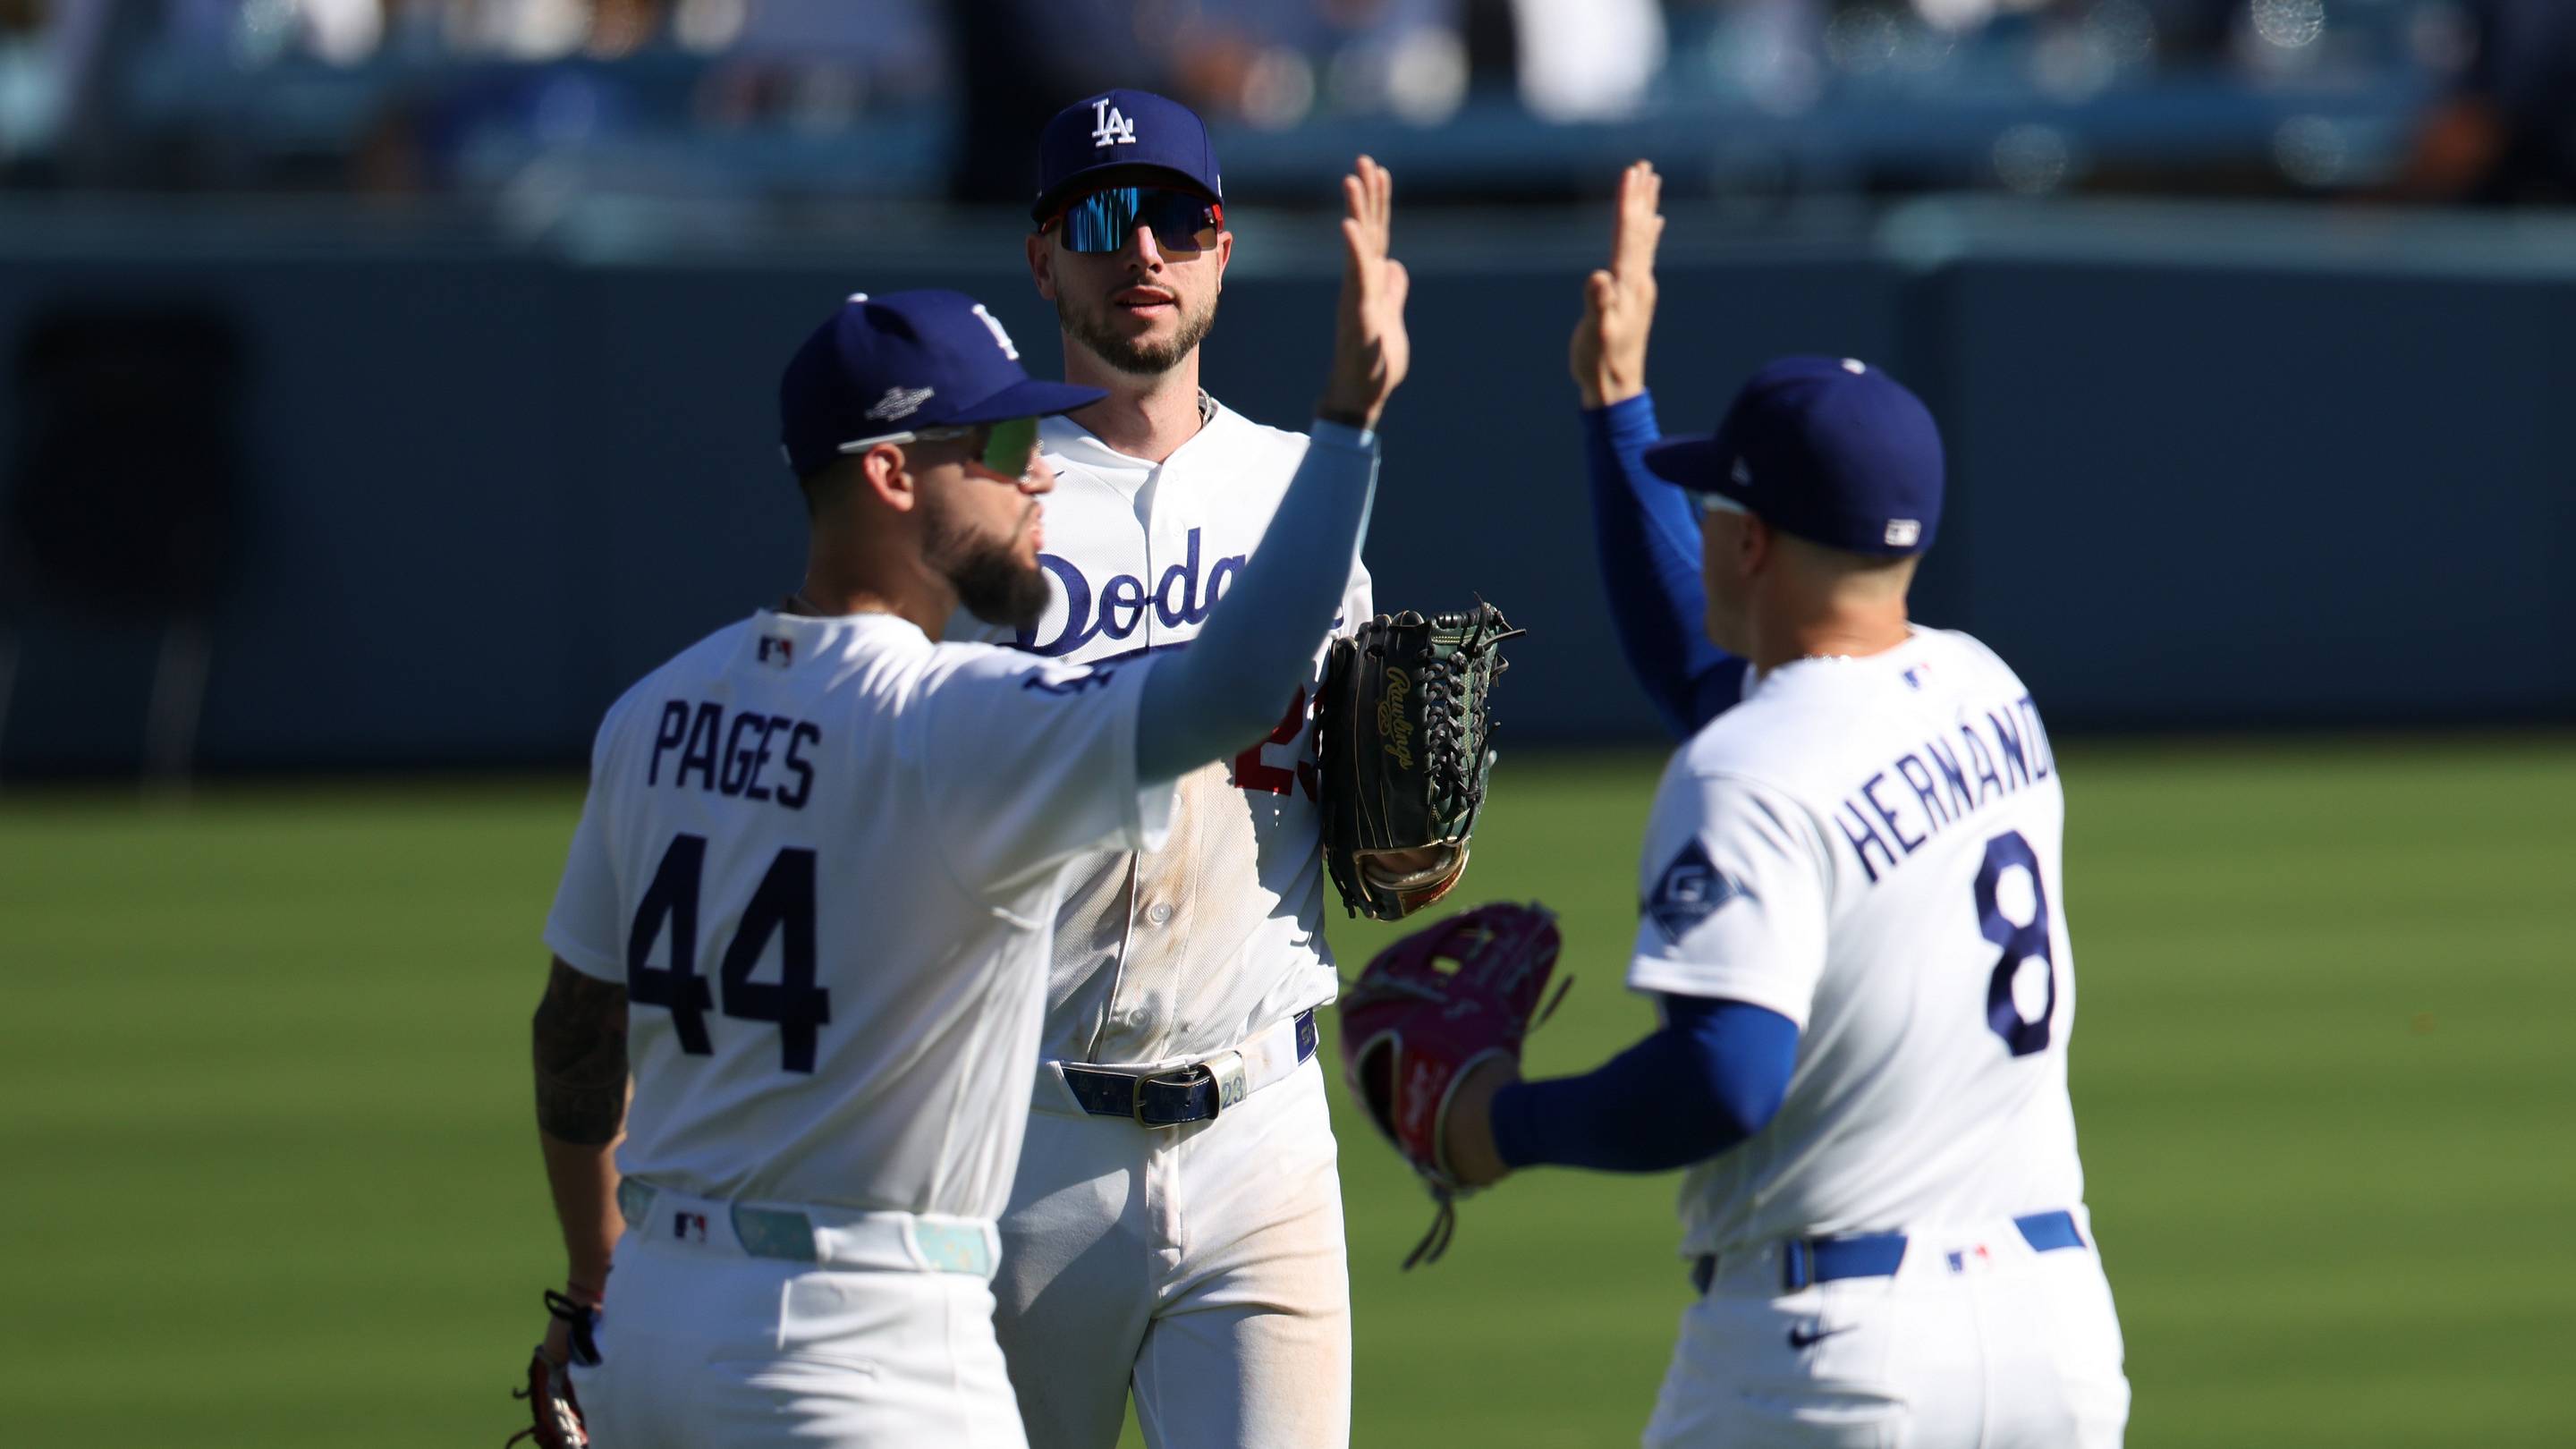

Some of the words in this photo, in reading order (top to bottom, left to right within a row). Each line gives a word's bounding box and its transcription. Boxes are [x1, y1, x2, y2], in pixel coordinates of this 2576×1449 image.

[1091, 97, 1136, 148] LA
[648, 699, 822, 810] PAGES
[1385, 666, 1413, 770] Rawlings
[628, 832, 831, 1074] 44
[1974, 830, 2056, 1057] 8
[1221, 1077, 1244, 1109] 23
